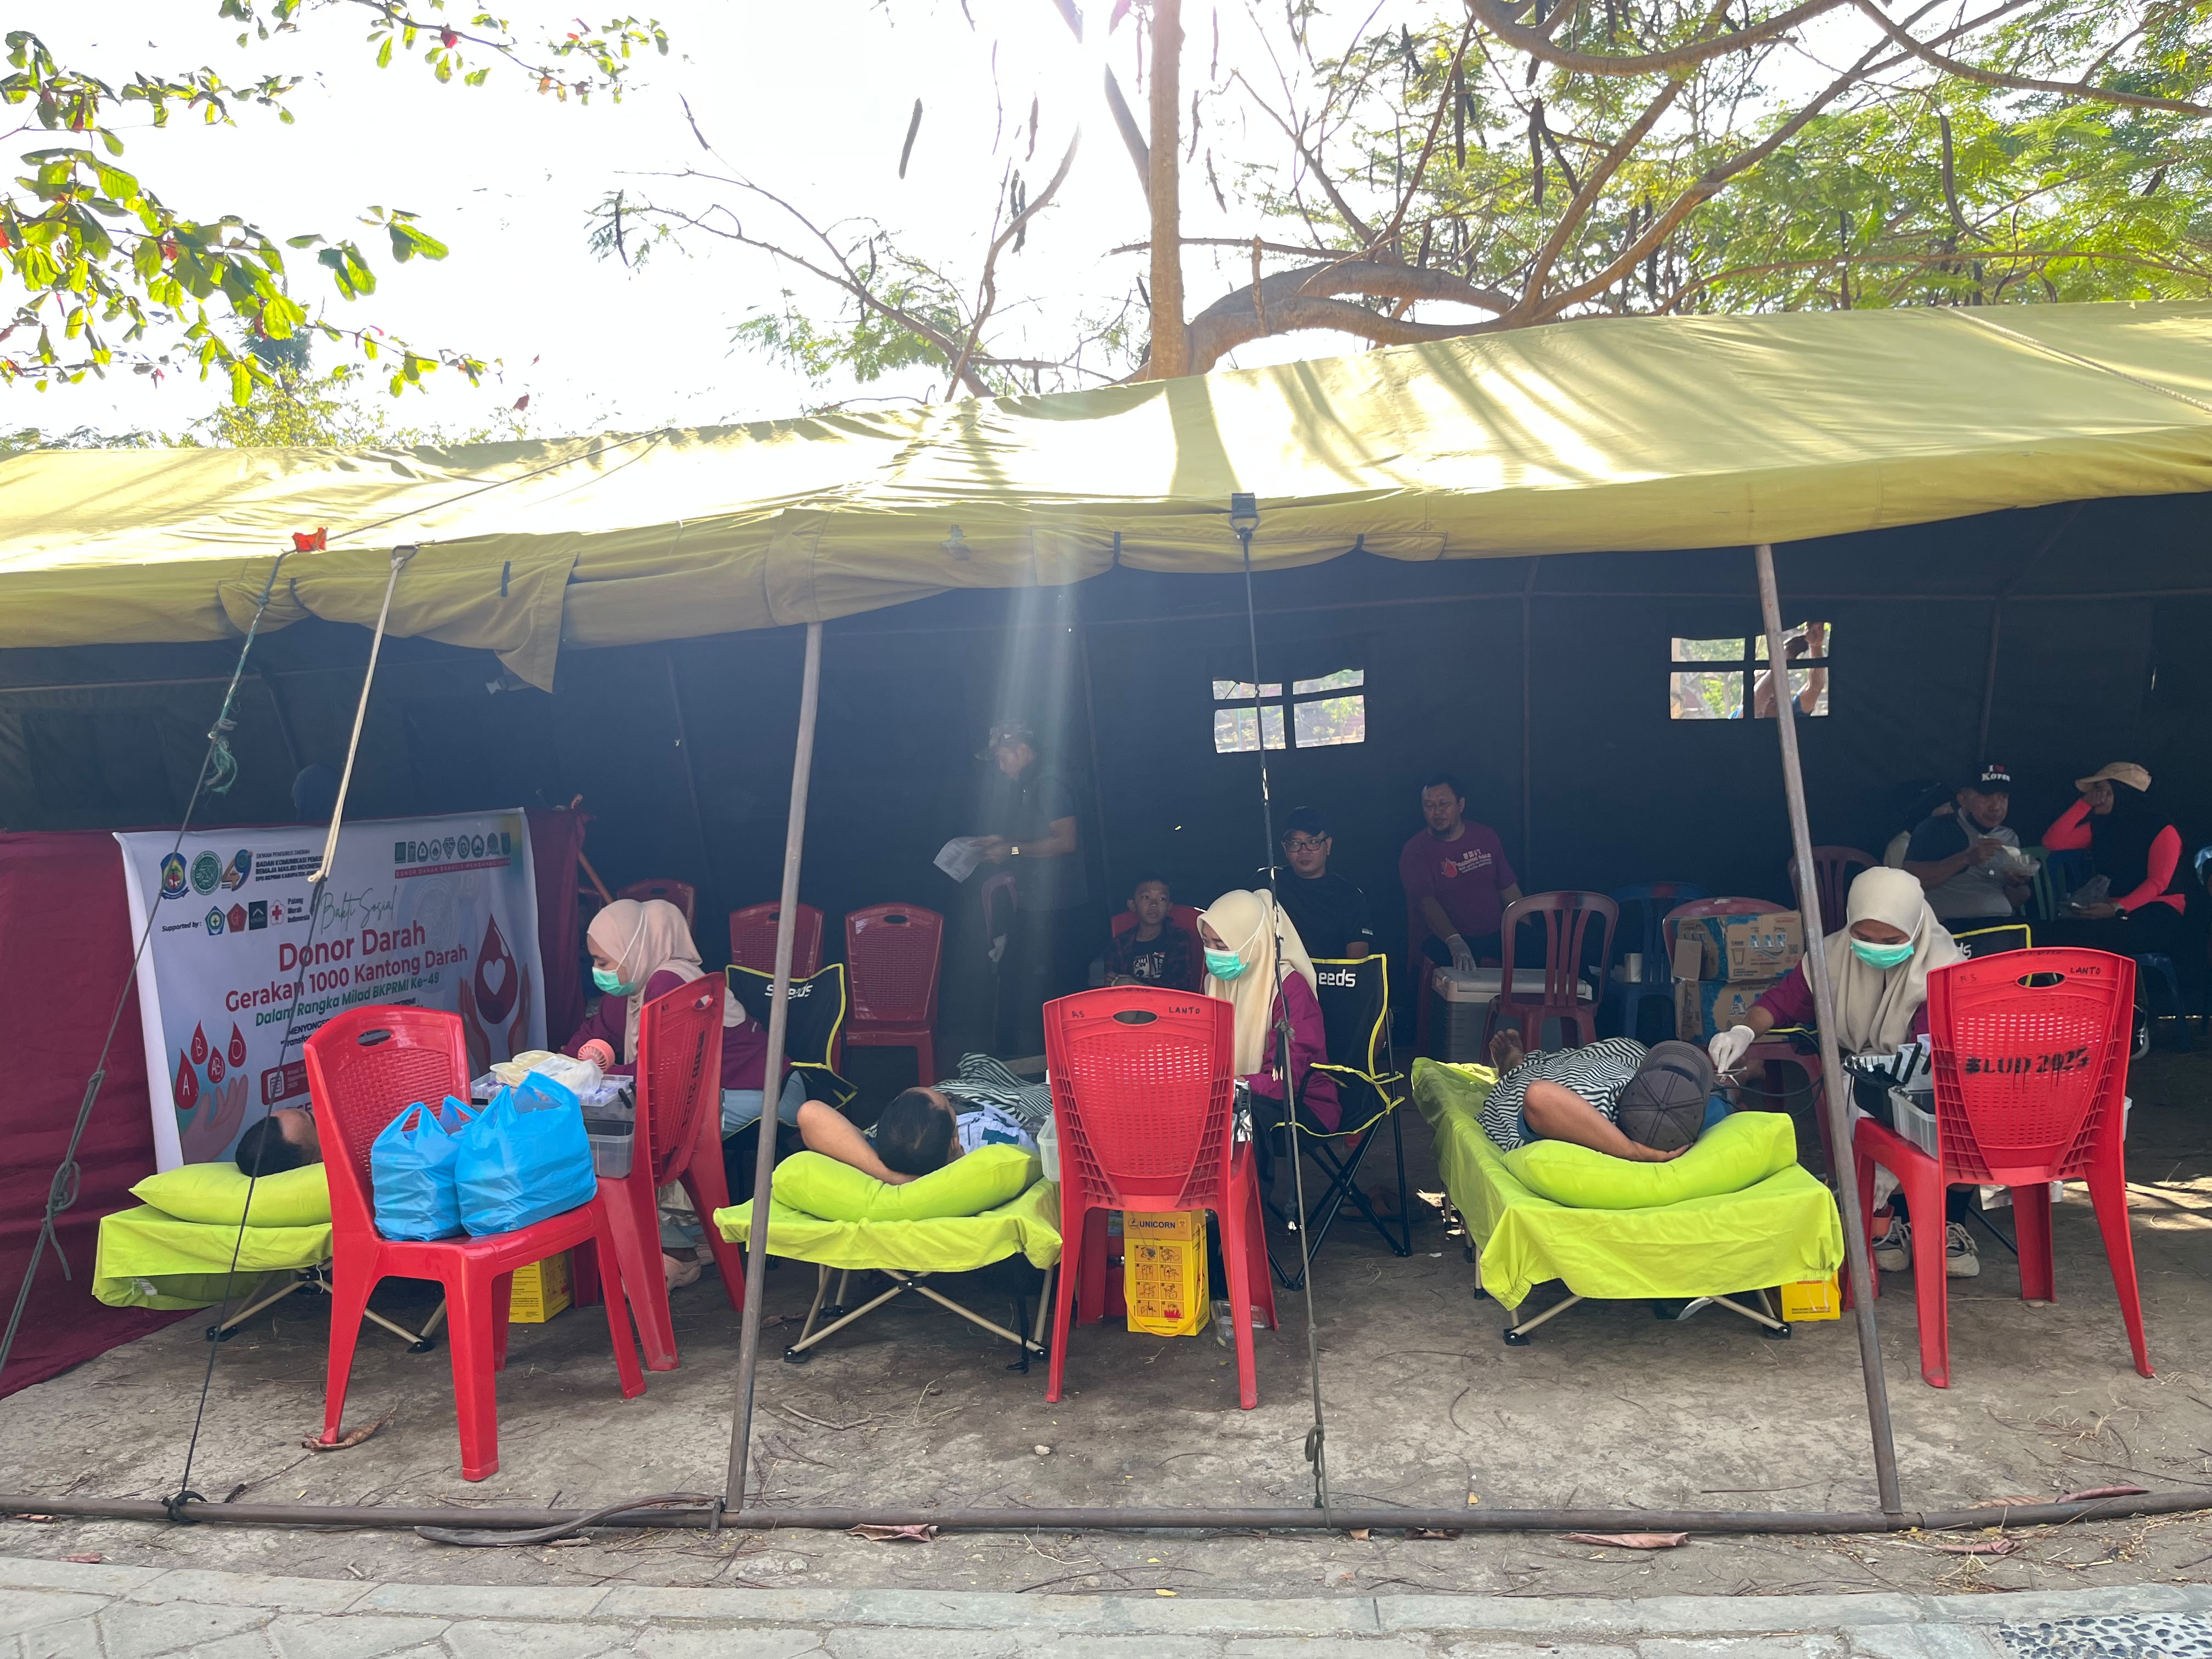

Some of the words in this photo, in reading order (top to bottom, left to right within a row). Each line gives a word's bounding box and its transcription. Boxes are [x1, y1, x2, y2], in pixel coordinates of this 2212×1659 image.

[321, 891, 361, 934] Bakti
[360, 885, 397, 928] Sosial
[162, 922, 191, 932] Supported
[279, 937, 354, 972] Donor
[362, 920, 425, 955] Darah
[226, 980, 304, 1012] Gerakan
[309, 967, 349, 993] 1000
[355, 956, 420, 983] Kantong
[425, 944, 467, 969] Darah
[1318, 969, 1356, 987] eeds
[2070, 967, 2101, 975] LANTO
[256, 1007, 293, 1026] Dalam
[297, 995, 340, 1015] Rangka
[342, 986, 370, 1006] Milad
[373, 979, 409, 998] BKPRMI
[411, 972, 439, 989] Ke-49
[195, 1037, 203, 1057] B
[183, 1073, 190, 1096] A
[1139, 1221, 1176, 1229] UNICORN
